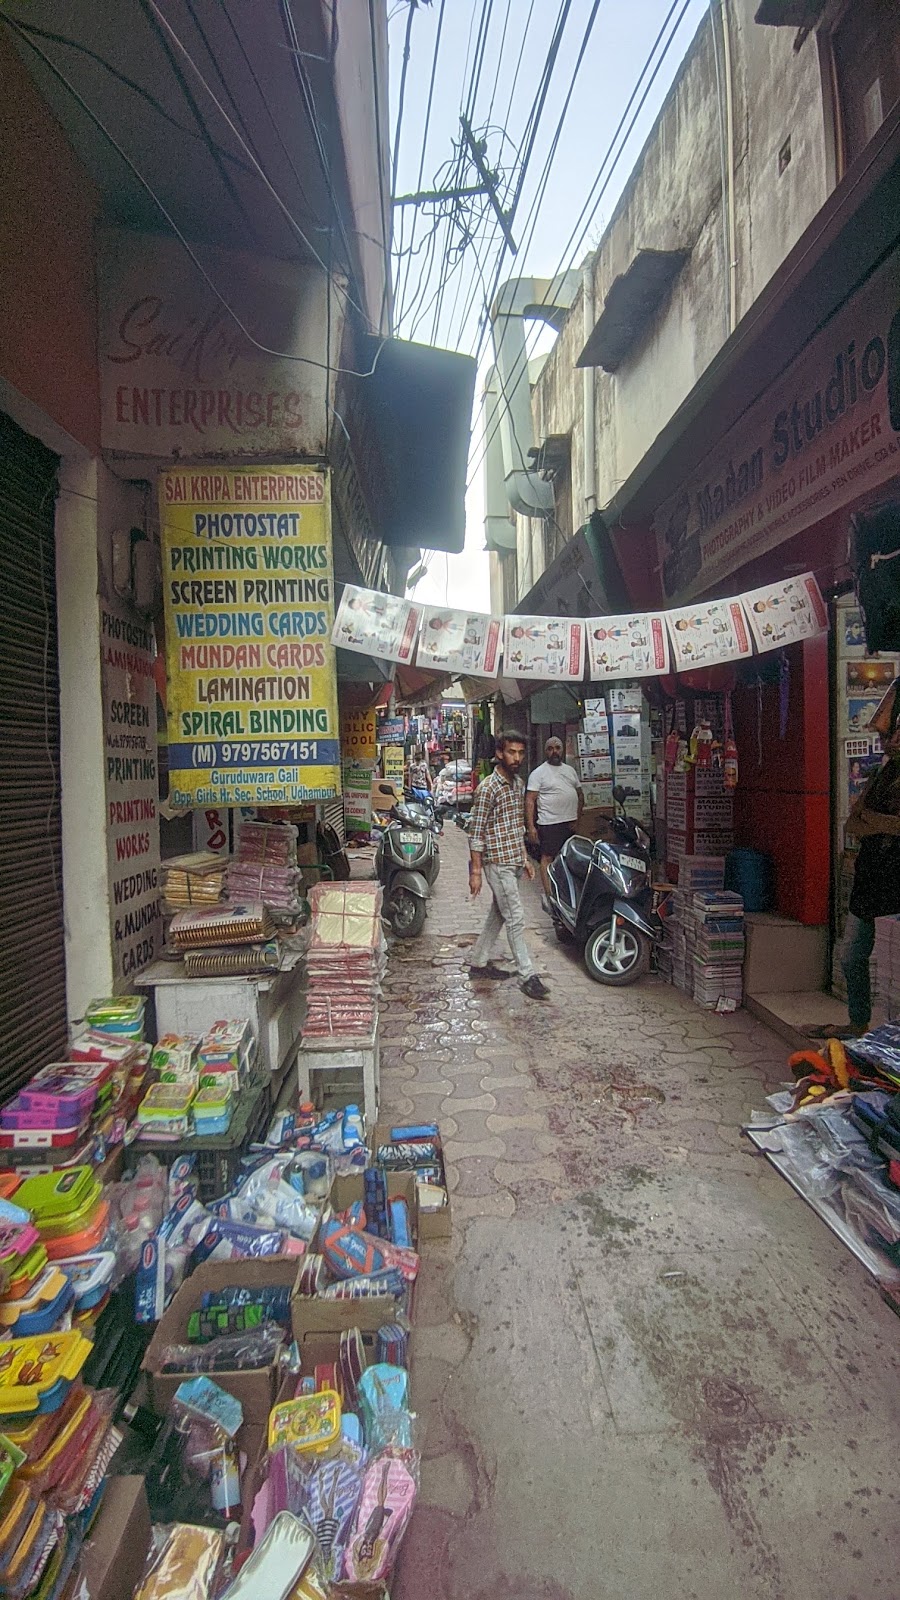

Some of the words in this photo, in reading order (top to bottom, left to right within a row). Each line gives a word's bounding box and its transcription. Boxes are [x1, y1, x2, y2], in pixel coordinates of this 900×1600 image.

[115, 385, 304, 434] ENTERPRISES
[698, 446, 763, 530] Madan
[770, 336, 886, 468] Studio
[165, 477, 187, 501] SAI
[190, 477, 230, 500] KRIPA
[235, 474, 325, 501] ENTERPRISES
[703, 510, 754, 560] PHOTOGRAPHY
[757, 506, 764, 520] &
[765, 477, 796, 512] VIDEO
[798, 452, 829, 492] FILM
[830, 412, 882, 468] MAKER
[195, 513, 301, 538] PHOTOSTAT
[171, 547, 257, 572] PRINTING
[262, 546, 328, 570] WORKS
[170, 580, 238, 606] SCREEN
[244, 579, 330, 606] PRINTING
[102, 609, 154, 653] PHOTOSTAT
[176, 612, 264, 638] WEDDING
[268, 611, 328, 637] CARDS
[102, 645, 154, 680] LAMINATION
[181, 645, 262, 671] MUNDAN
[267, 643, 326, 668] CARDS
[198, 675, 310, 704] LAMINATION
[110, 699, 150, 728] SCREEN
[182, 711, 245, 737] SPIRAL
[249, 709, 328, 734] BINDING
[191, 745, 217, 767] (M)
[222, 742, 318, 762] 9797567151
[107, 757, 156, 783] PRINTING
[211, 769, 275, 786] Guruduwara
[277, 768, 299, 783] Gali
[173, 790, 194, 806] Opp.
[196, 788, 218, 803] Girls
[220, 788, 233, 802] Hr.
[234, 787, 254, 802] Sec.
[109, 799, 156, 826] PRINTING
[115, 831, 151, 862] WORKS
[113, 868, 158, 905] WEDDING
[114, 919, 123, 941] &
[122, 936, 155, 977] CARDS
